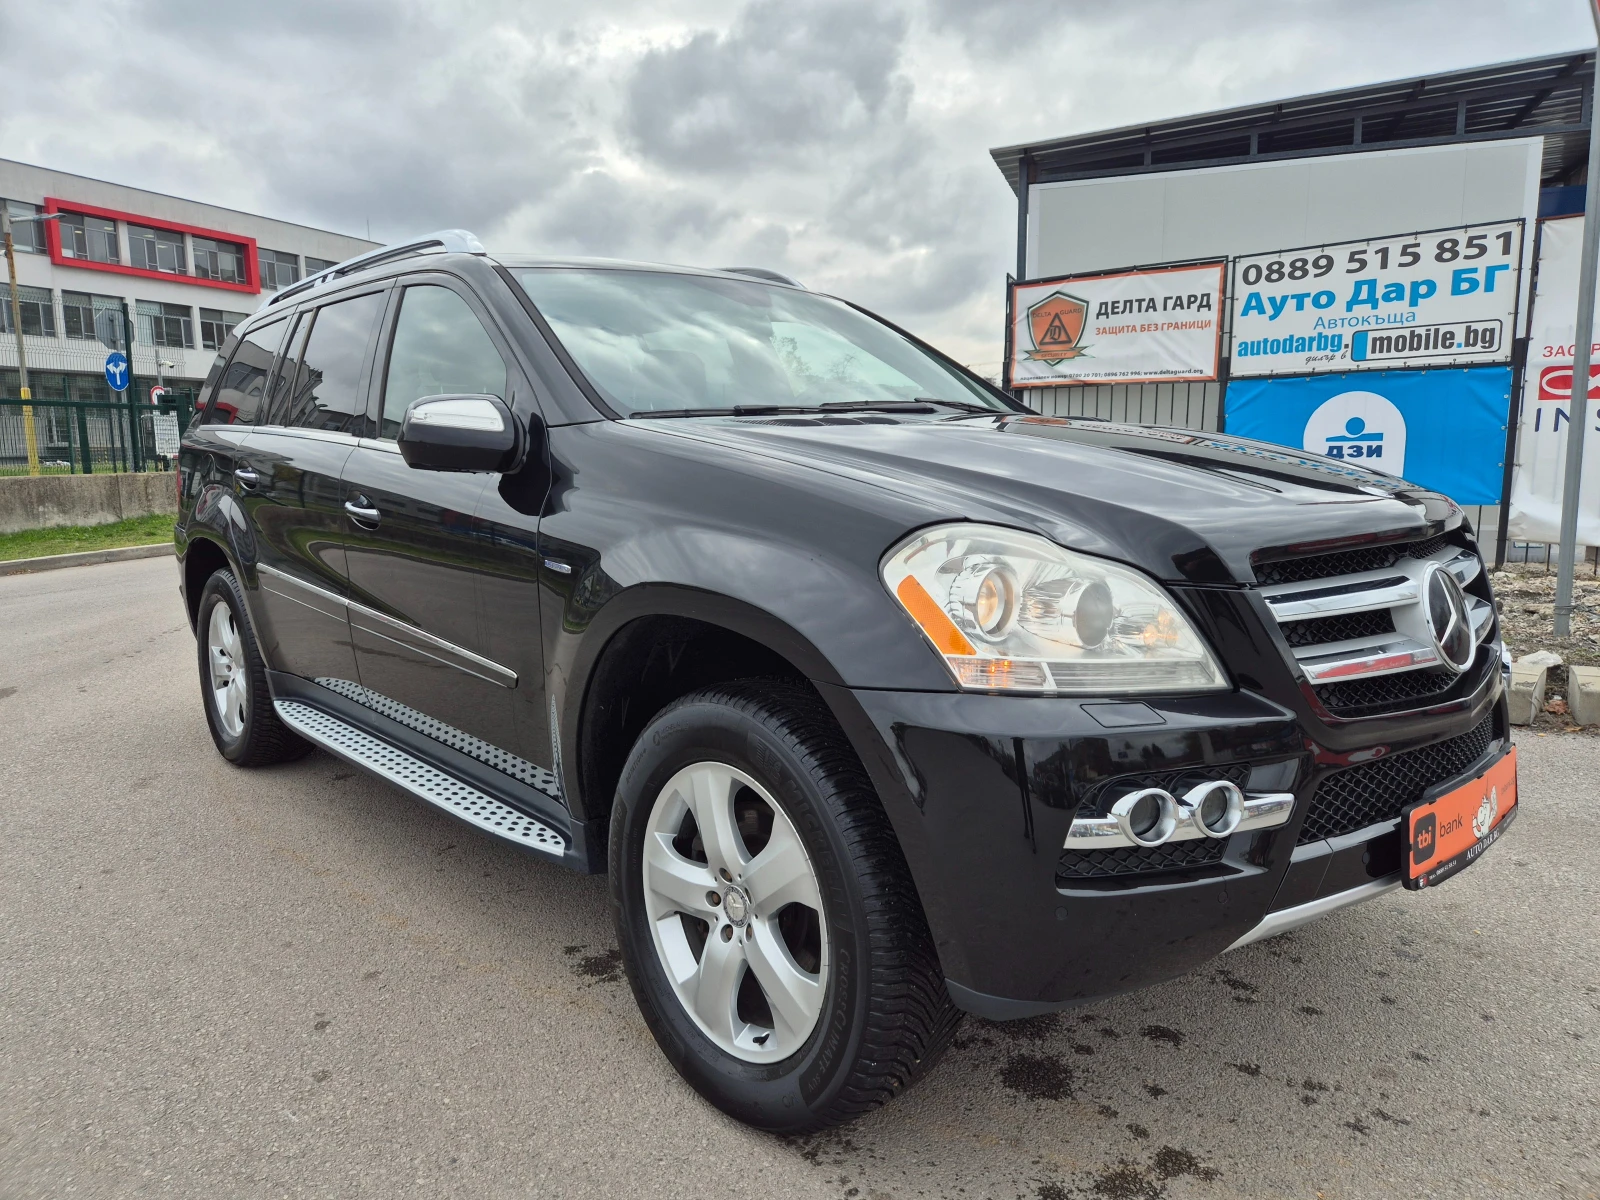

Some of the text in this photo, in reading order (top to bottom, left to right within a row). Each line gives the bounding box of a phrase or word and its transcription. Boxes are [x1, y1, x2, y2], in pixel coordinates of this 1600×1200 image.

[1242, 231, 1512, 286] 0889 515 851
[1240, 263, 1510, 322] Ауто Дар БГ
[1032, 307, 1083, 319] DELTA GUARD
[1095, 292, 1212, 320] ДЕЛТА ГАРД
[1095, 319, 1212, 336] ЗАЩИТА БЕЗ ГРАНИЦИ
[1313, 311, 1417, 331] Автокъща
[1370, 324, 1496, 355] mobile.bg
[1143, 368, 1204, 376] www.deltaguard.org
[1325, 445, 1383, 459] ДЗИ
[1417, 813, 1463, 848] tbi bank
[1466, 842, 1483, 860] AUTO
[1483, 834, 1493, 849] DAR
